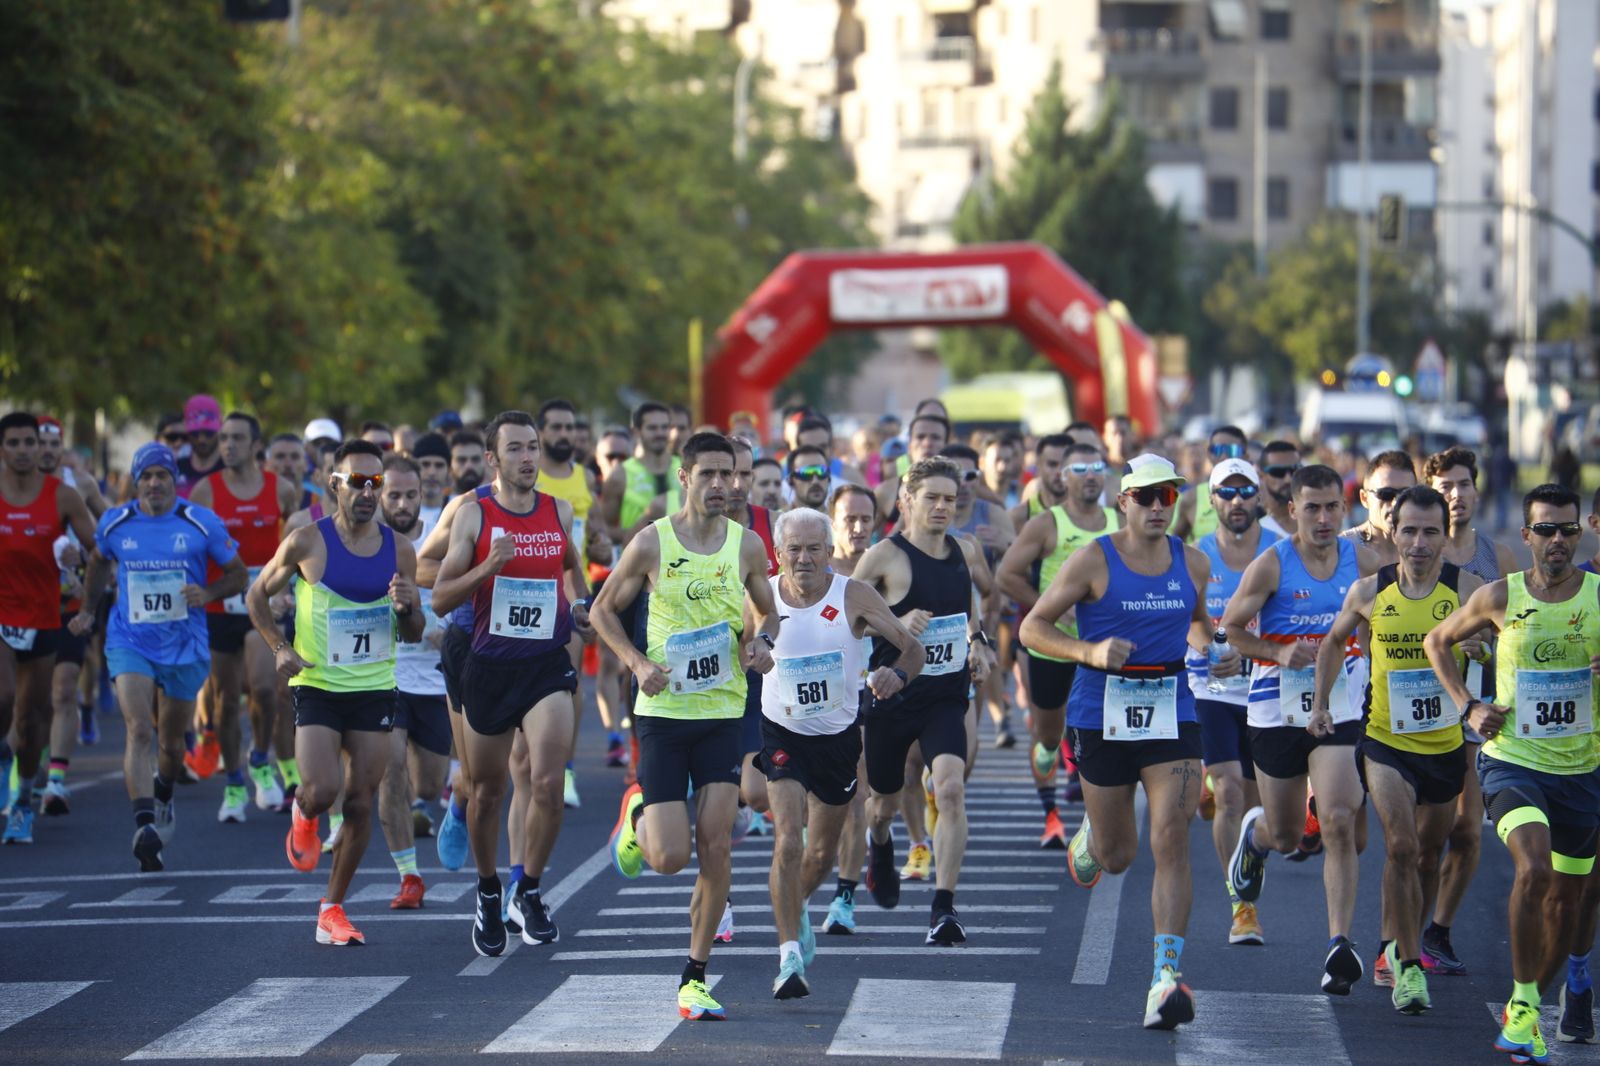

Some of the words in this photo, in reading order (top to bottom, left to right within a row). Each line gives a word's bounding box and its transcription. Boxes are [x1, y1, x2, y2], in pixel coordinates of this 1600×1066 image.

[143, 593, 172, 611] 579
[1121, 600, 1185, 611] TROTASIERRA
[508, 605, 542, 628] 502
[352, 633, 370, 654] 71
[925, 643, 953, 665] 524
[796, 679, 829, 705] 581
[1125, 706, 1155, 728] 157
[1536, 700, 1576, 726] 348
